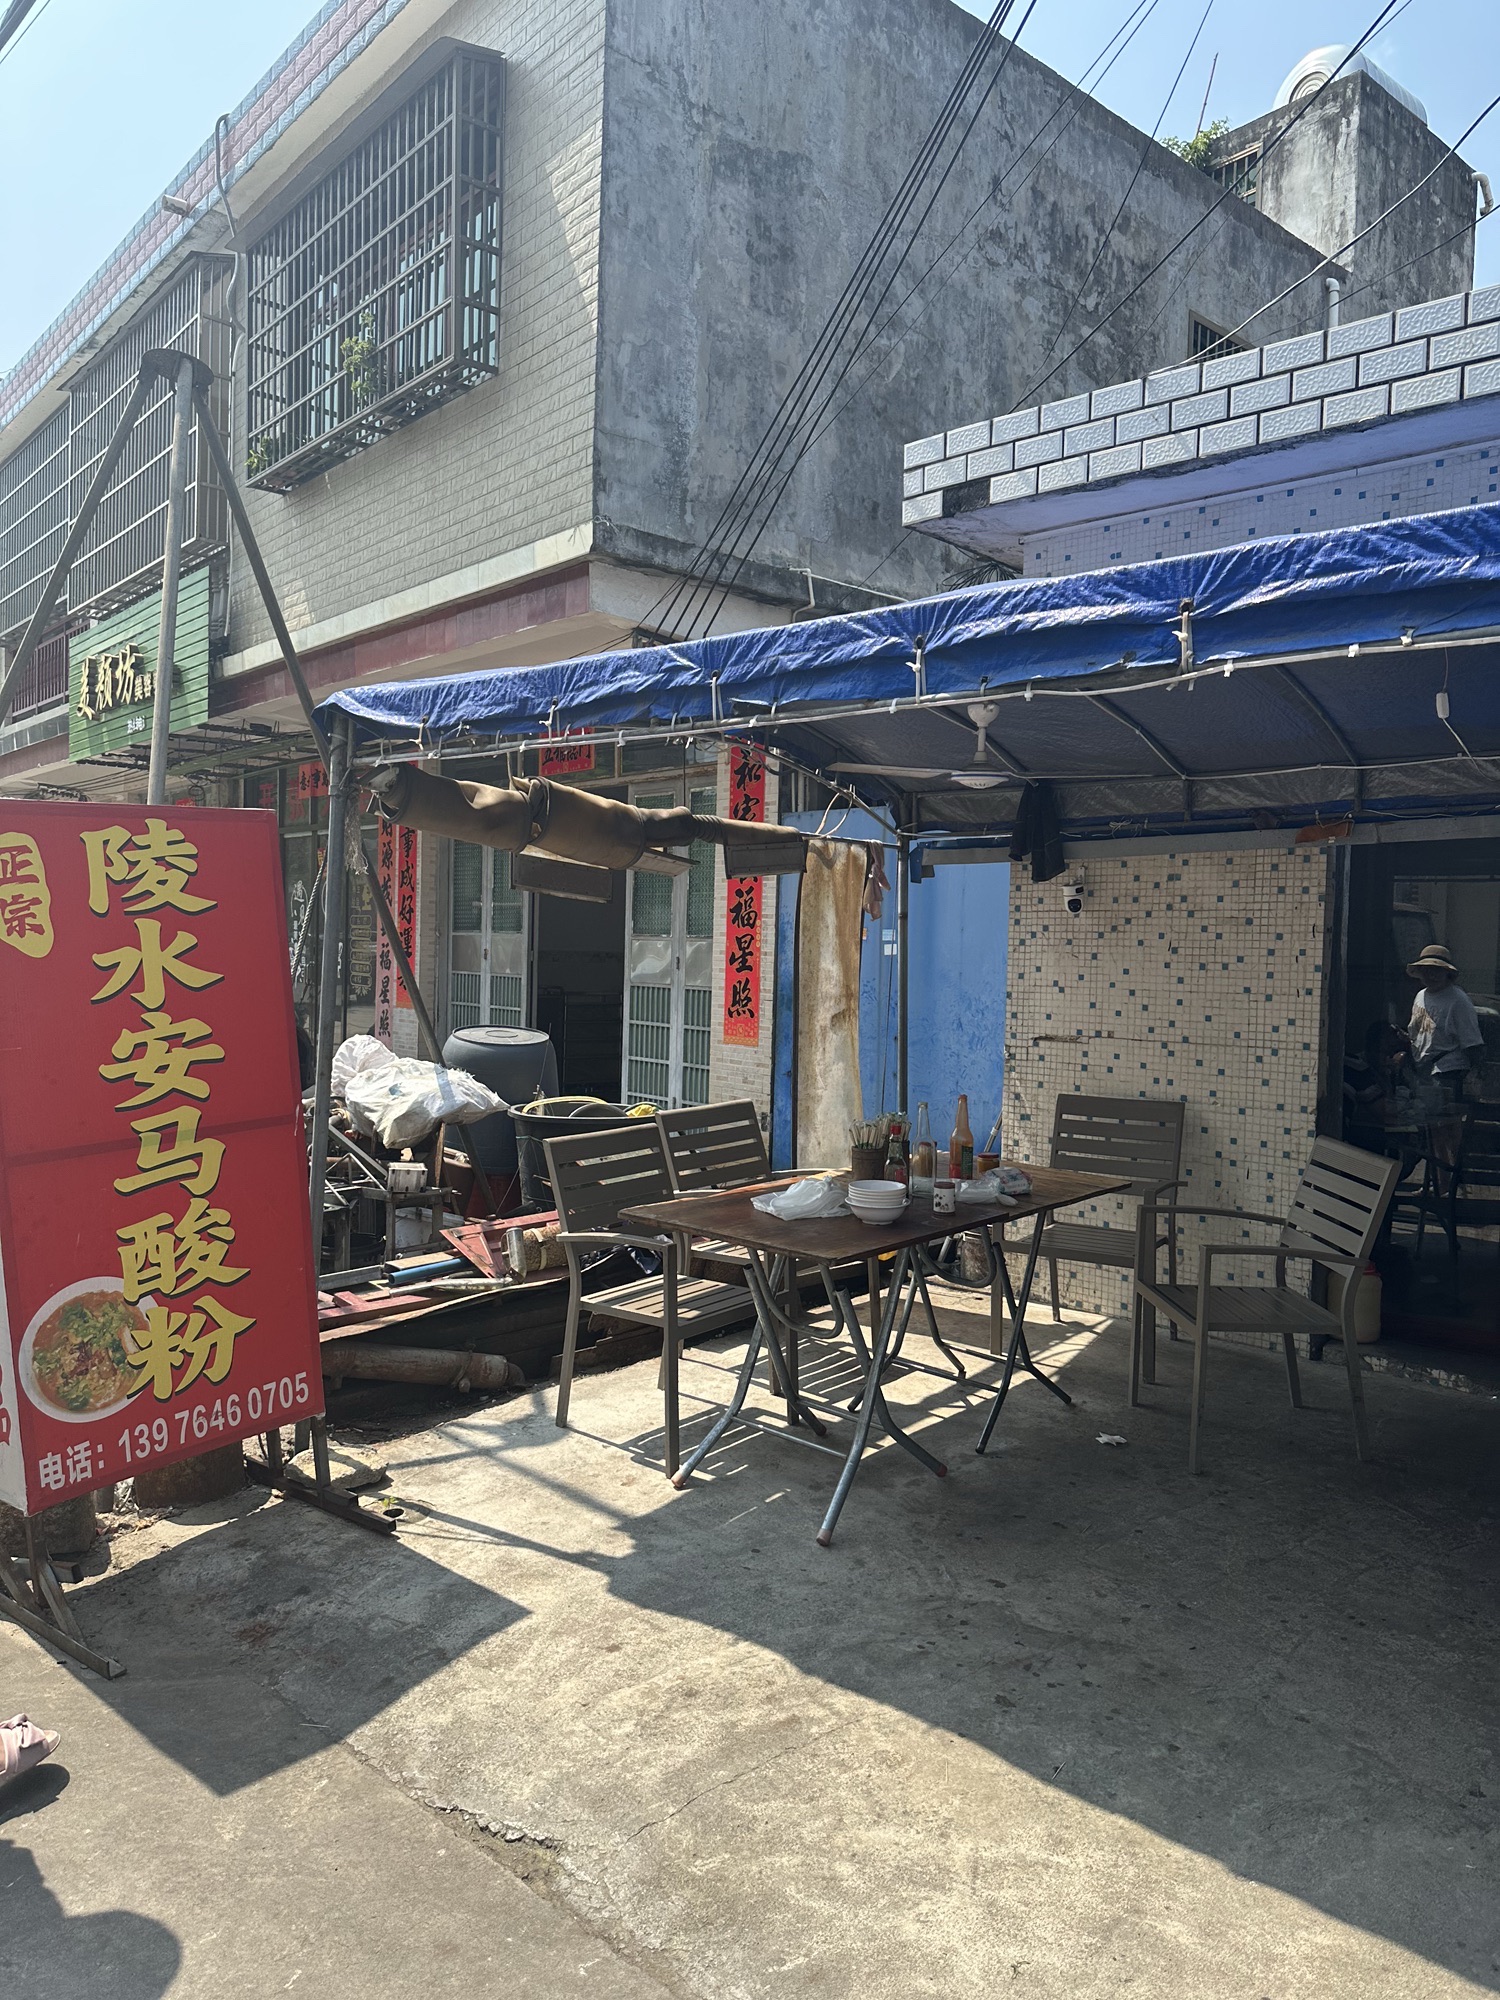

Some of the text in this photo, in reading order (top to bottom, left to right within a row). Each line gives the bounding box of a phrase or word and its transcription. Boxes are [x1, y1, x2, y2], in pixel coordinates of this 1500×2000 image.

[0, 844, 46, 938] 正宗
[79, 818, 257, 1402] 陵水安马酸粉
